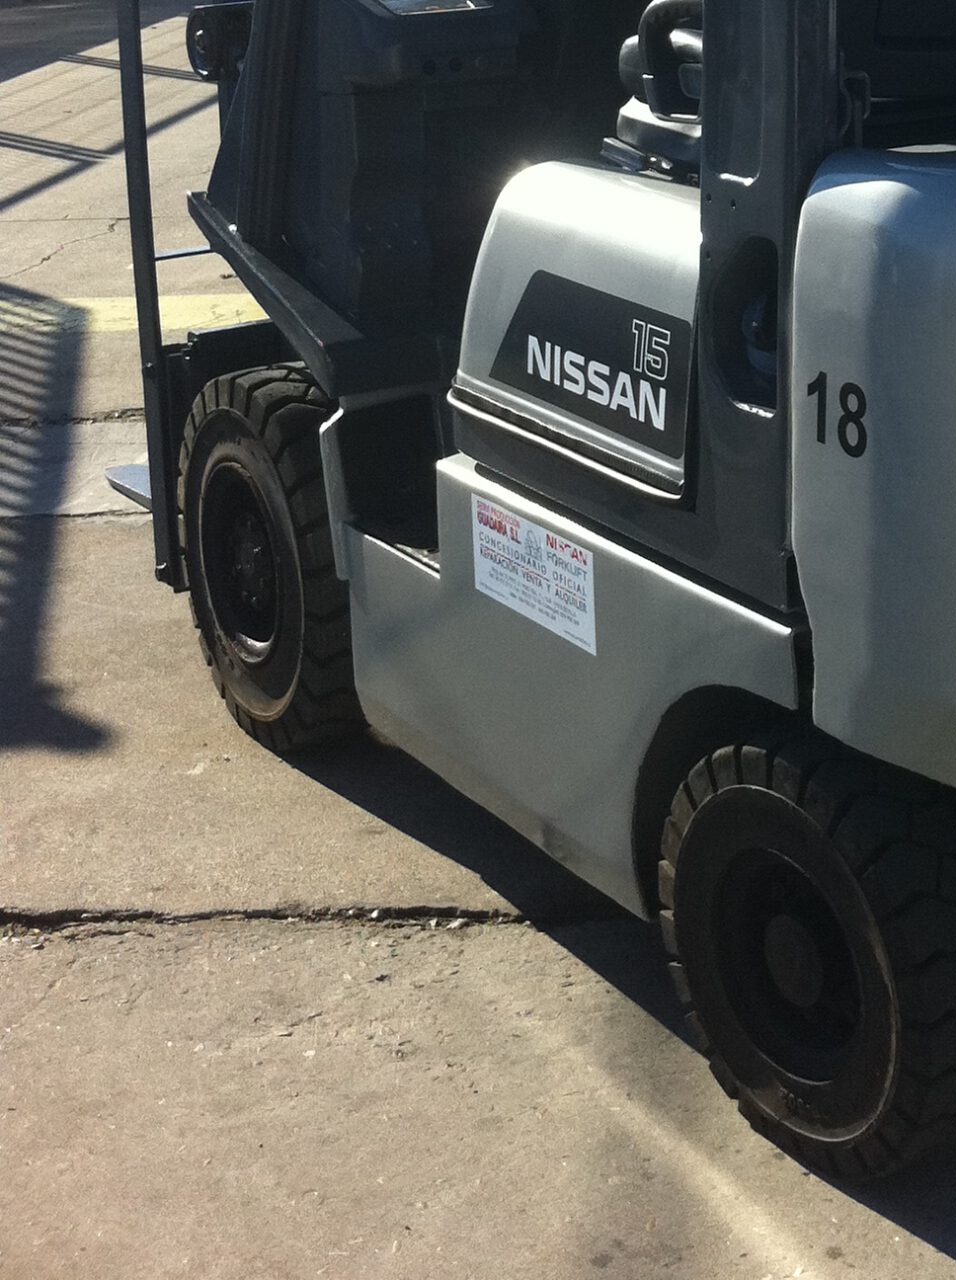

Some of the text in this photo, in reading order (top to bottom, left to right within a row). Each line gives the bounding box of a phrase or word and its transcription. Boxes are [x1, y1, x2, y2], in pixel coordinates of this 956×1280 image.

[527, 333, 667, 431] NISSAN
[631, 318, 671, 381] 15
[807, 370, 868, 458] 18
[552, 570, 587, 597] OFICIAL
